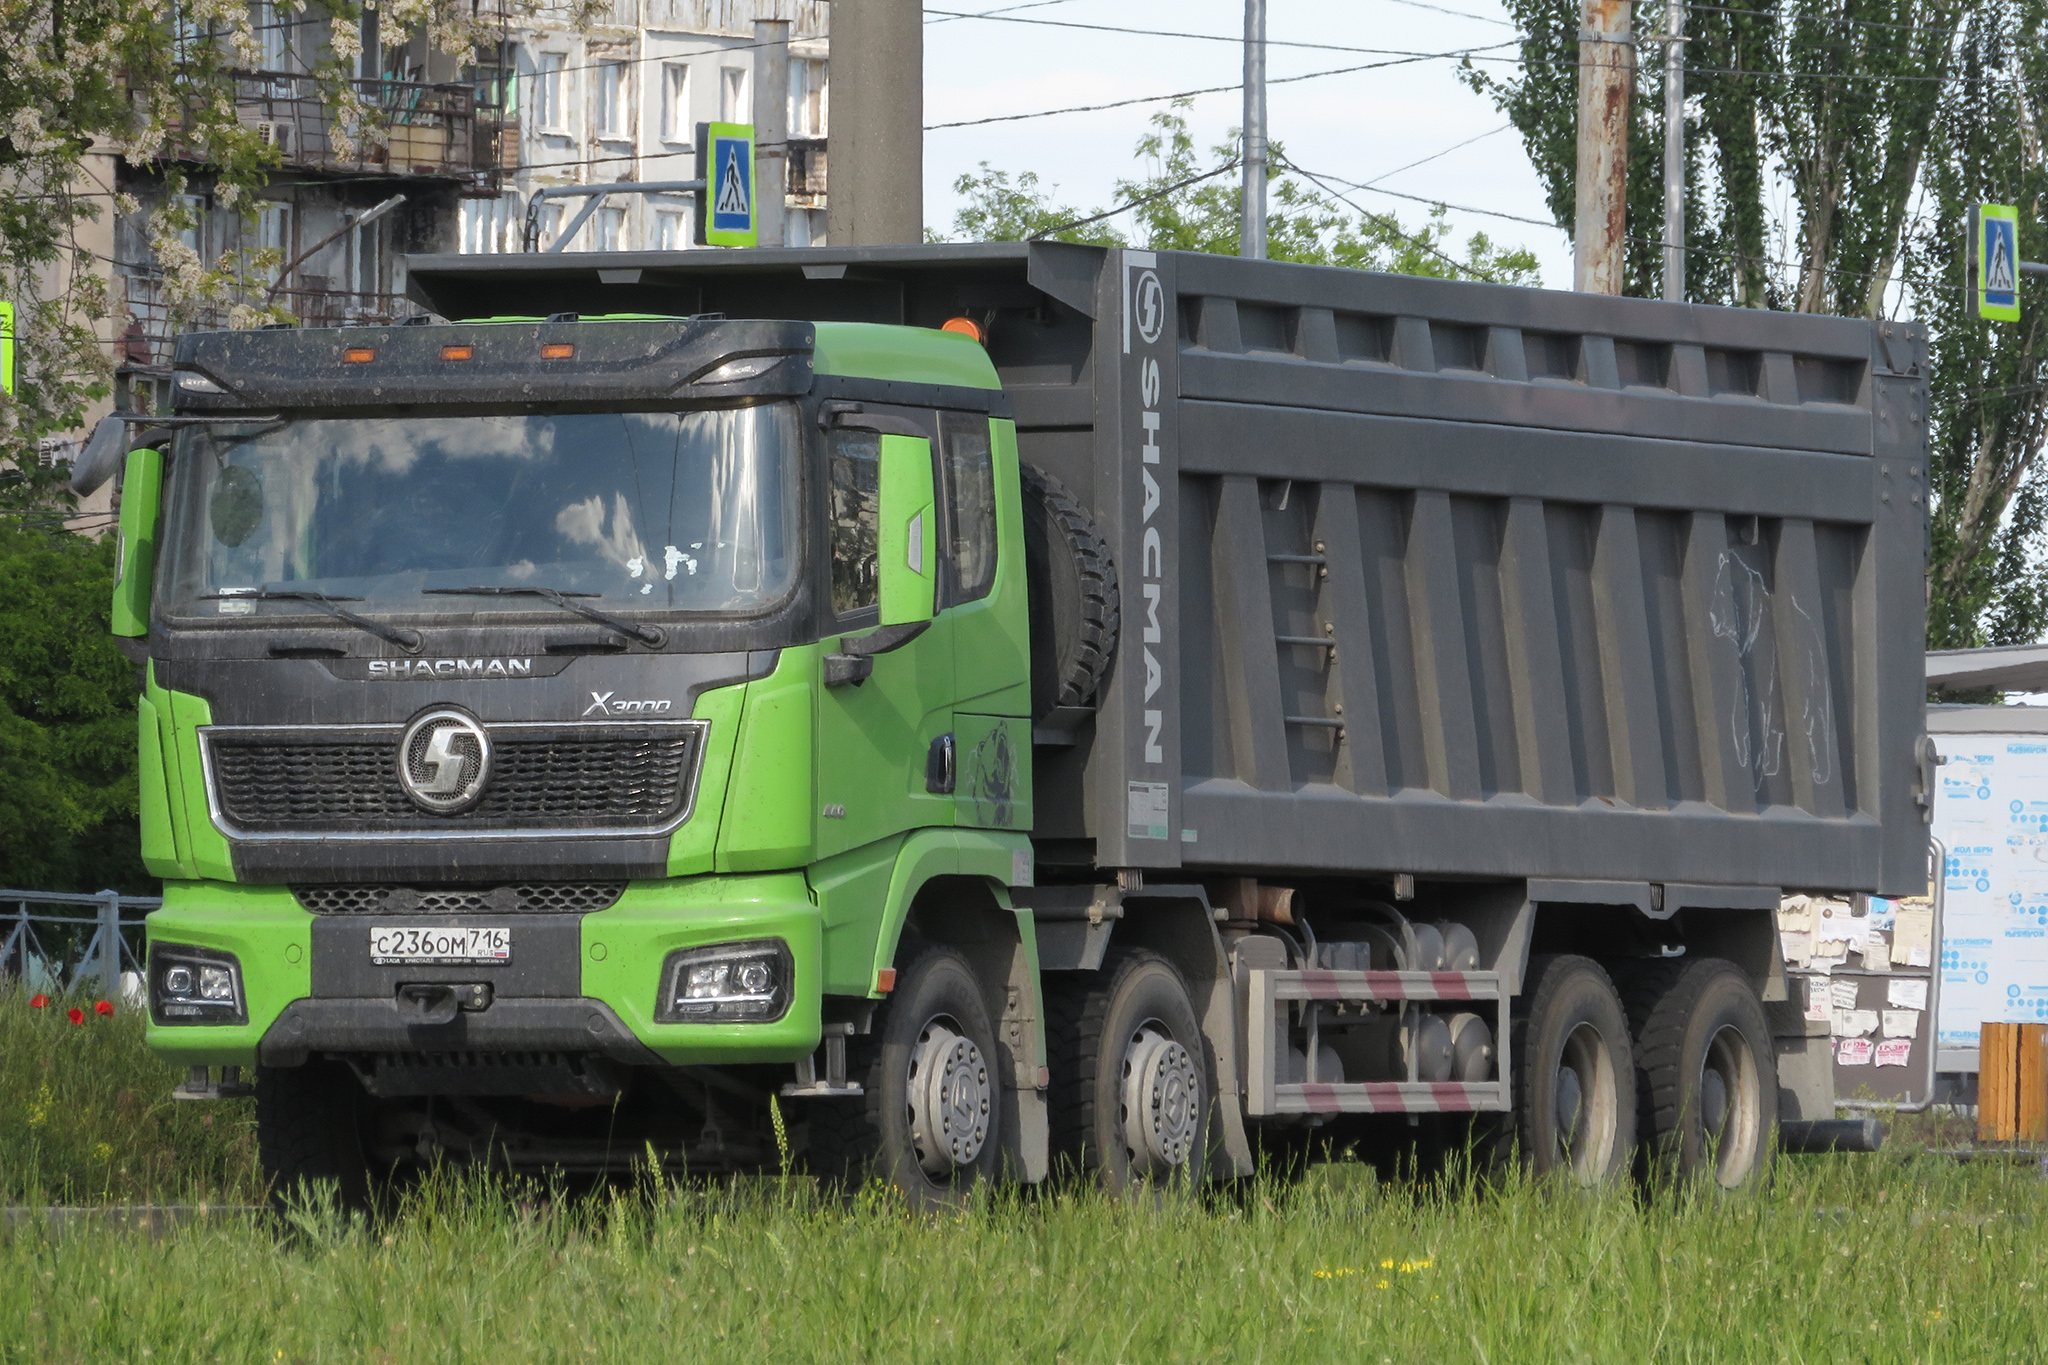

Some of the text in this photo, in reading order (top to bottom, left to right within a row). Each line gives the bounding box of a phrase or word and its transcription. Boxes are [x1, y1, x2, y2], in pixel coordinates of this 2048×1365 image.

[1141, 356, 1163, 764] SHACMAN
[368, 658, 532, 677] SHACMAN
[582, 691, 672, 716] X3000
[469, 930, 503, 949] 716
